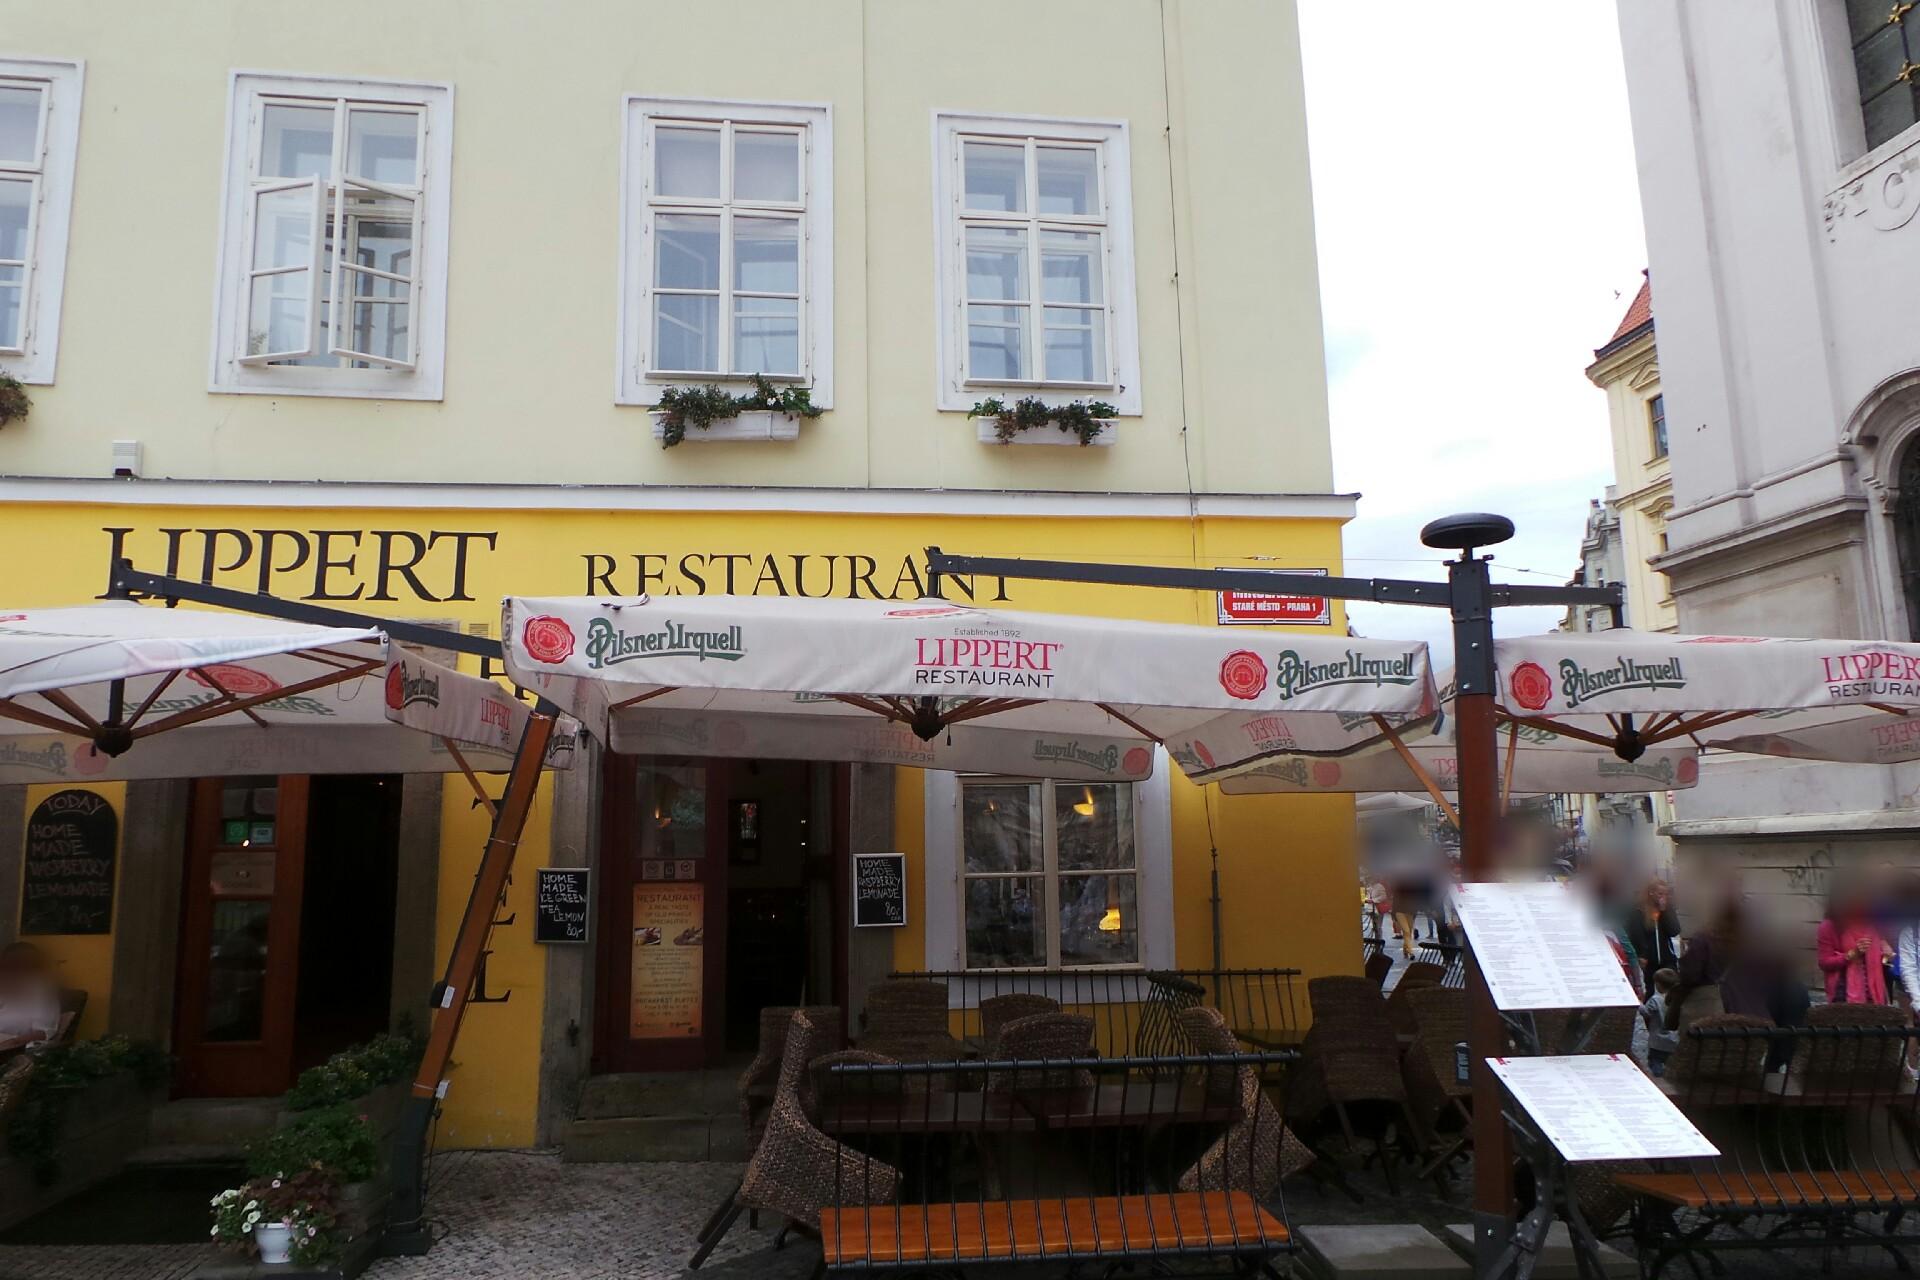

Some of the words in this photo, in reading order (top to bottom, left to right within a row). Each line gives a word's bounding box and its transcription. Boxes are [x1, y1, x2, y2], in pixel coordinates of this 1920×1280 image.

[95, 527, 498, 606] LIPPERT
[580, 552, 1014, 602] RESTAURANT
[1232, 600, 1255, 611] STARÉ
[1287, 602, 1310, 612] PRAHA
[1312, 603, 1316, 612] 1
[954, 627, 999, 638] Established
[585, 617, 669, 668] Pilsner
[665, 620, 742, 662] Urquell
[915, 638, 1058, 670] LIPPERT
[915, 669, 1055, 688] RESTAURANT
[1276, 649, 1348, 700] Pilsner
[1345, 649, 1414, 688] Urquell
[1559, 658, 1621, 708] Pilsner
[1618, 656, 1683, 691] Urquell
[44, 794, 105, 815] TODAY
[31, 823, 82, 839] HOME
[31, 839, 88, 856] MADE
[859, 859, 892, 868] HOME
[543, 874, 578, 884] HOME
[862, 867, 896, 877] MADE
[542, 883, 578, 893] MADE
[555, 893, 586, 904] GREEN
[540, 904, 560, 914] TEA
[553, 911, 585, 922] LEMON
